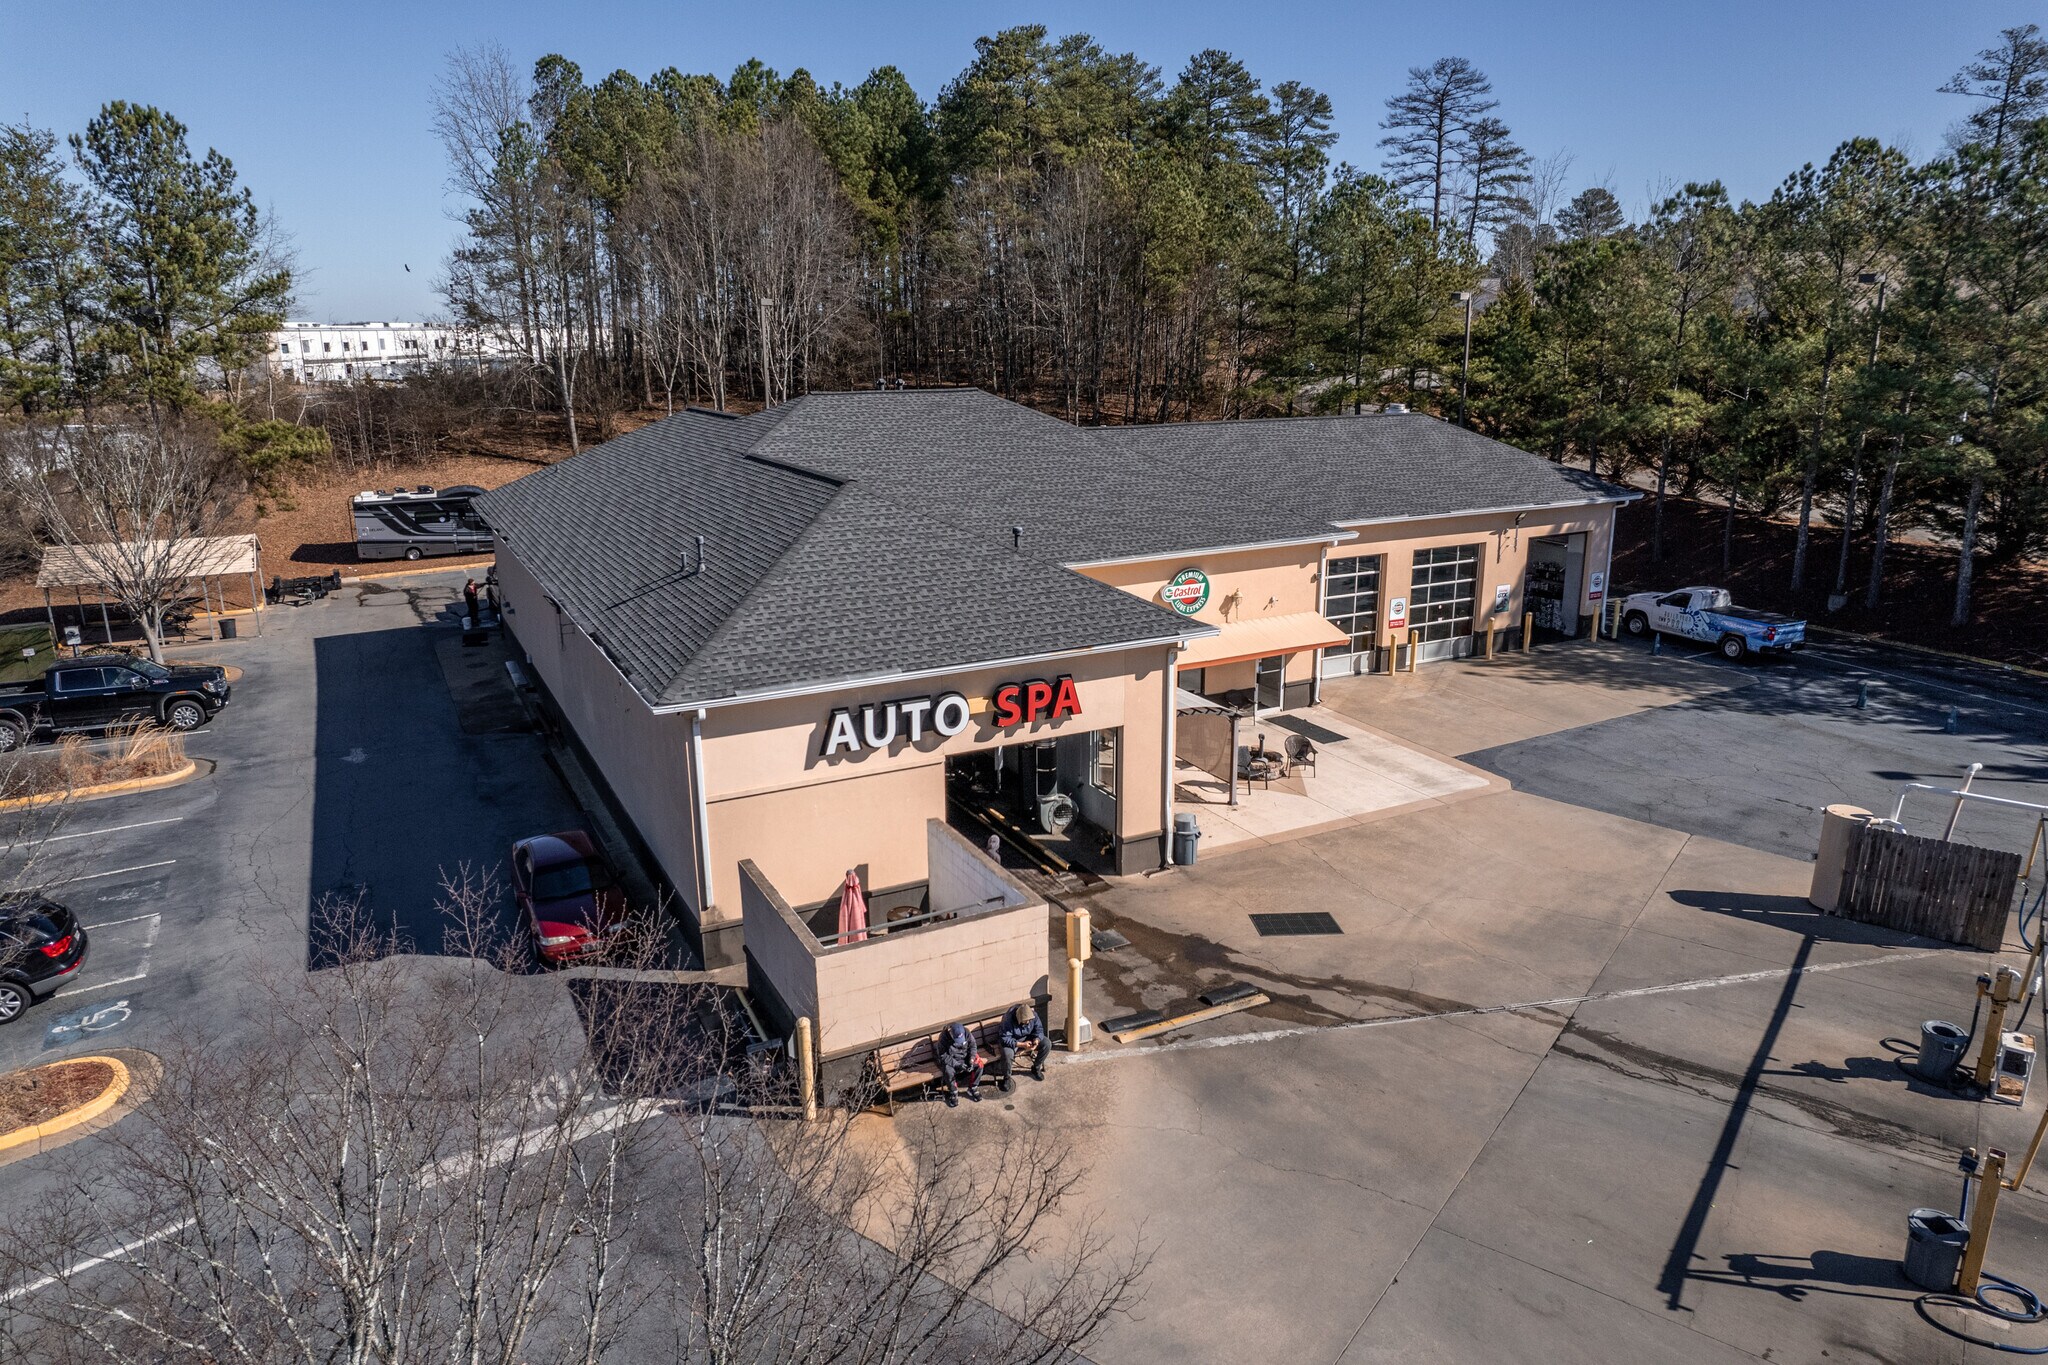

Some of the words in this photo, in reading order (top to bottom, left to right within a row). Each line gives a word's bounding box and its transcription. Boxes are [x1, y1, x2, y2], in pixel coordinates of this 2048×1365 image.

[1178, 571, 1204, 583] PREMIUM
[1173, 585, 1201, 597] Castrol
[1174, 600, 1186, 612] LUBE
[1187, 597, 1206, 612] EXPRESS
[821, 693, 970, 756] AUTO
[993, 675, 1082, 727] SPA
